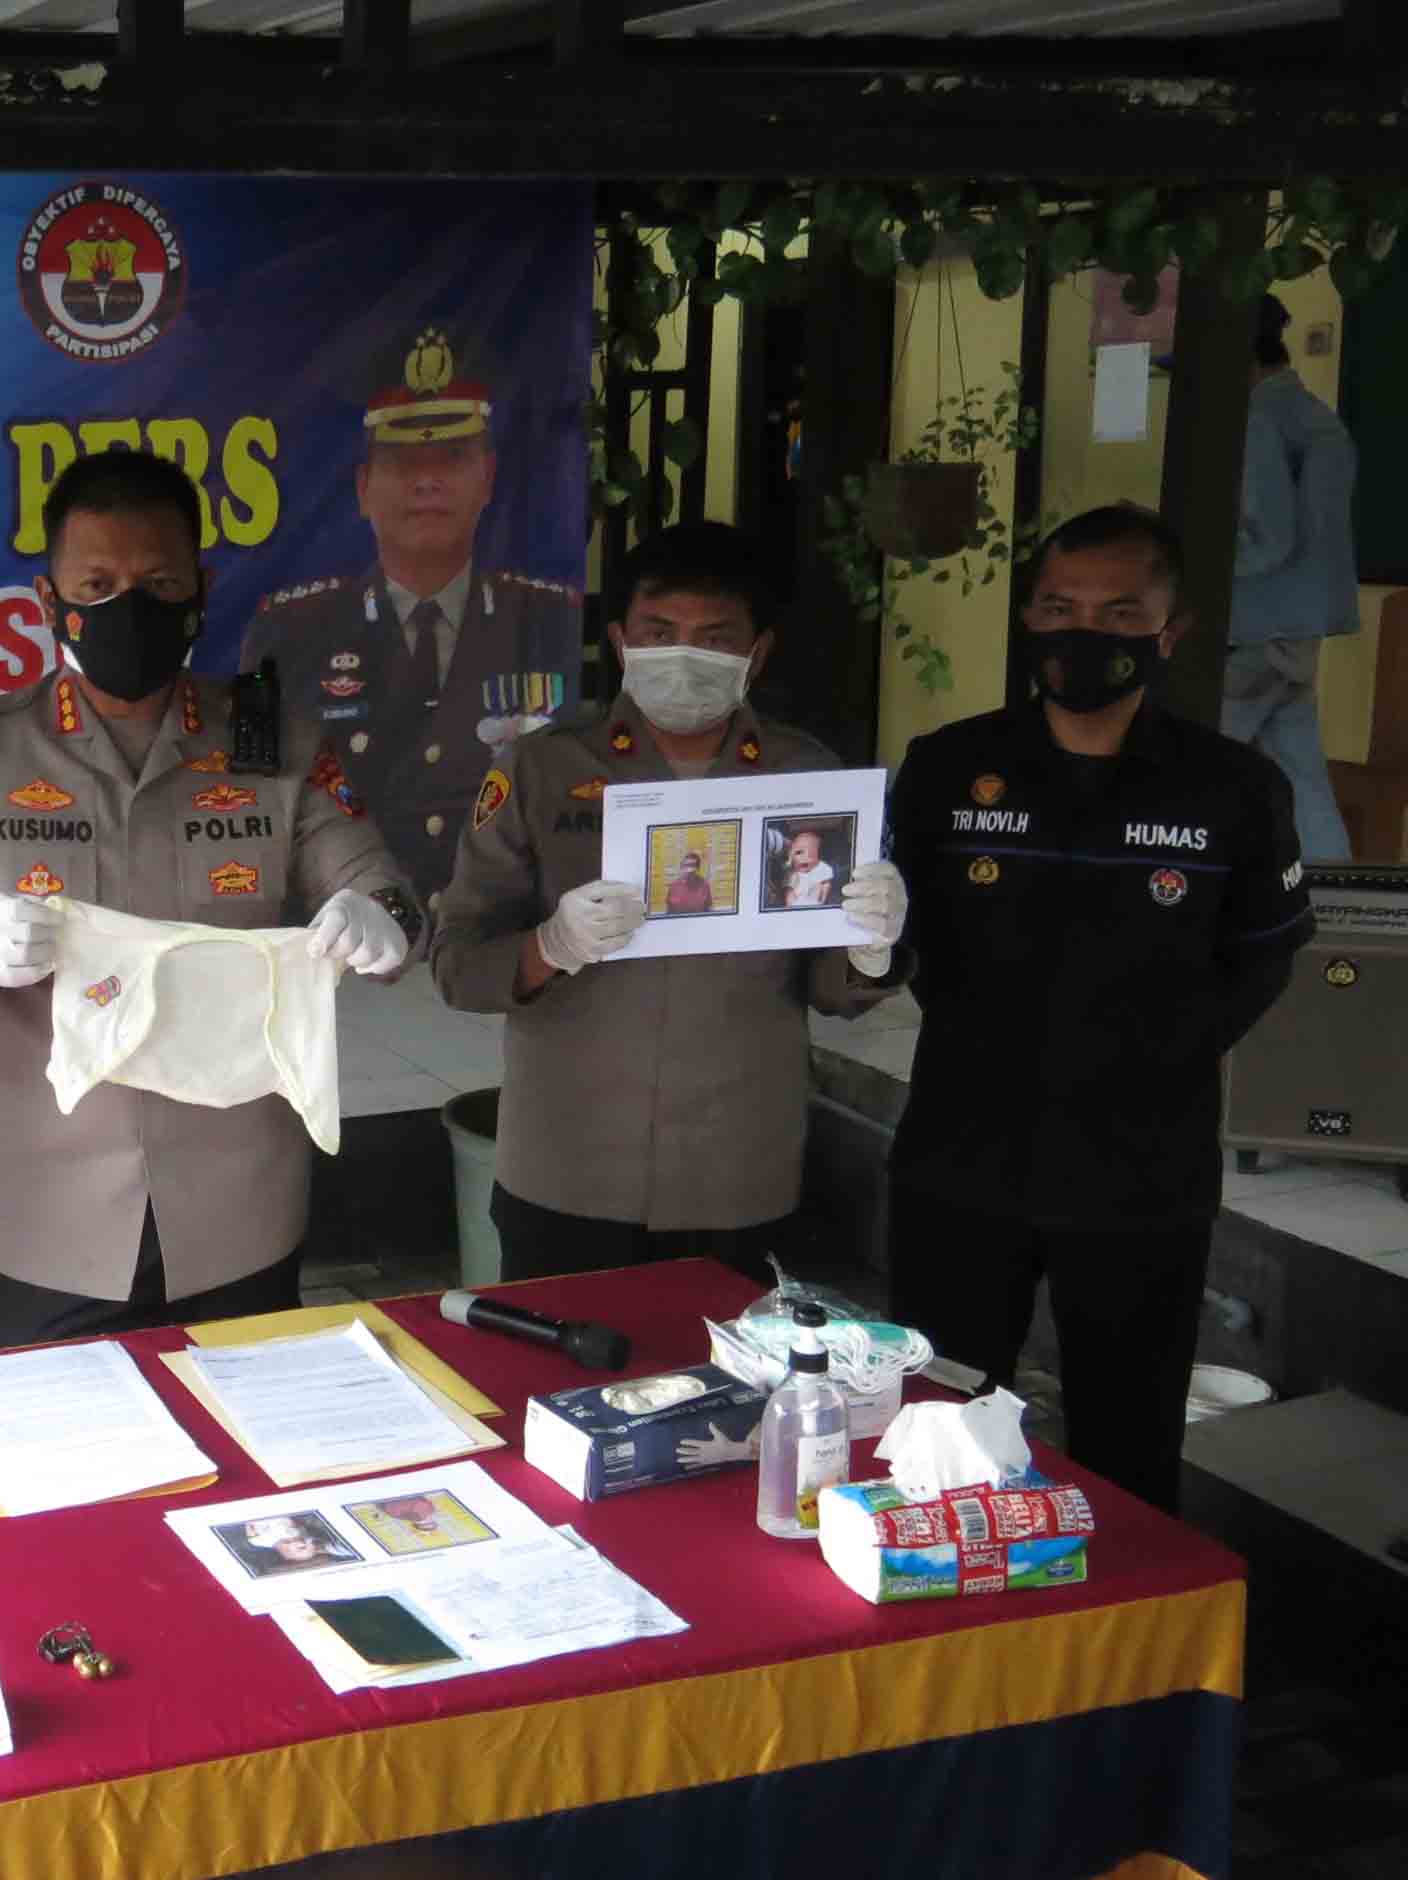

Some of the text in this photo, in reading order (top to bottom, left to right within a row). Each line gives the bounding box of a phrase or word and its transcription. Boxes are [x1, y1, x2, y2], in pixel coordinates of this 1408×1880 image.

[22, 185, 86, 272] OBYEKTIF
[103, 184, 181, 271] DIPERCAYA
[45, 322, 160, 359] PARTISIPASI
[4, 412, 283, 558] PRS
[184, 815, 273, 843] POLRI
[951, 810, 973, 832] TRI
[1125, 823, 1208, 851] HUMAS
